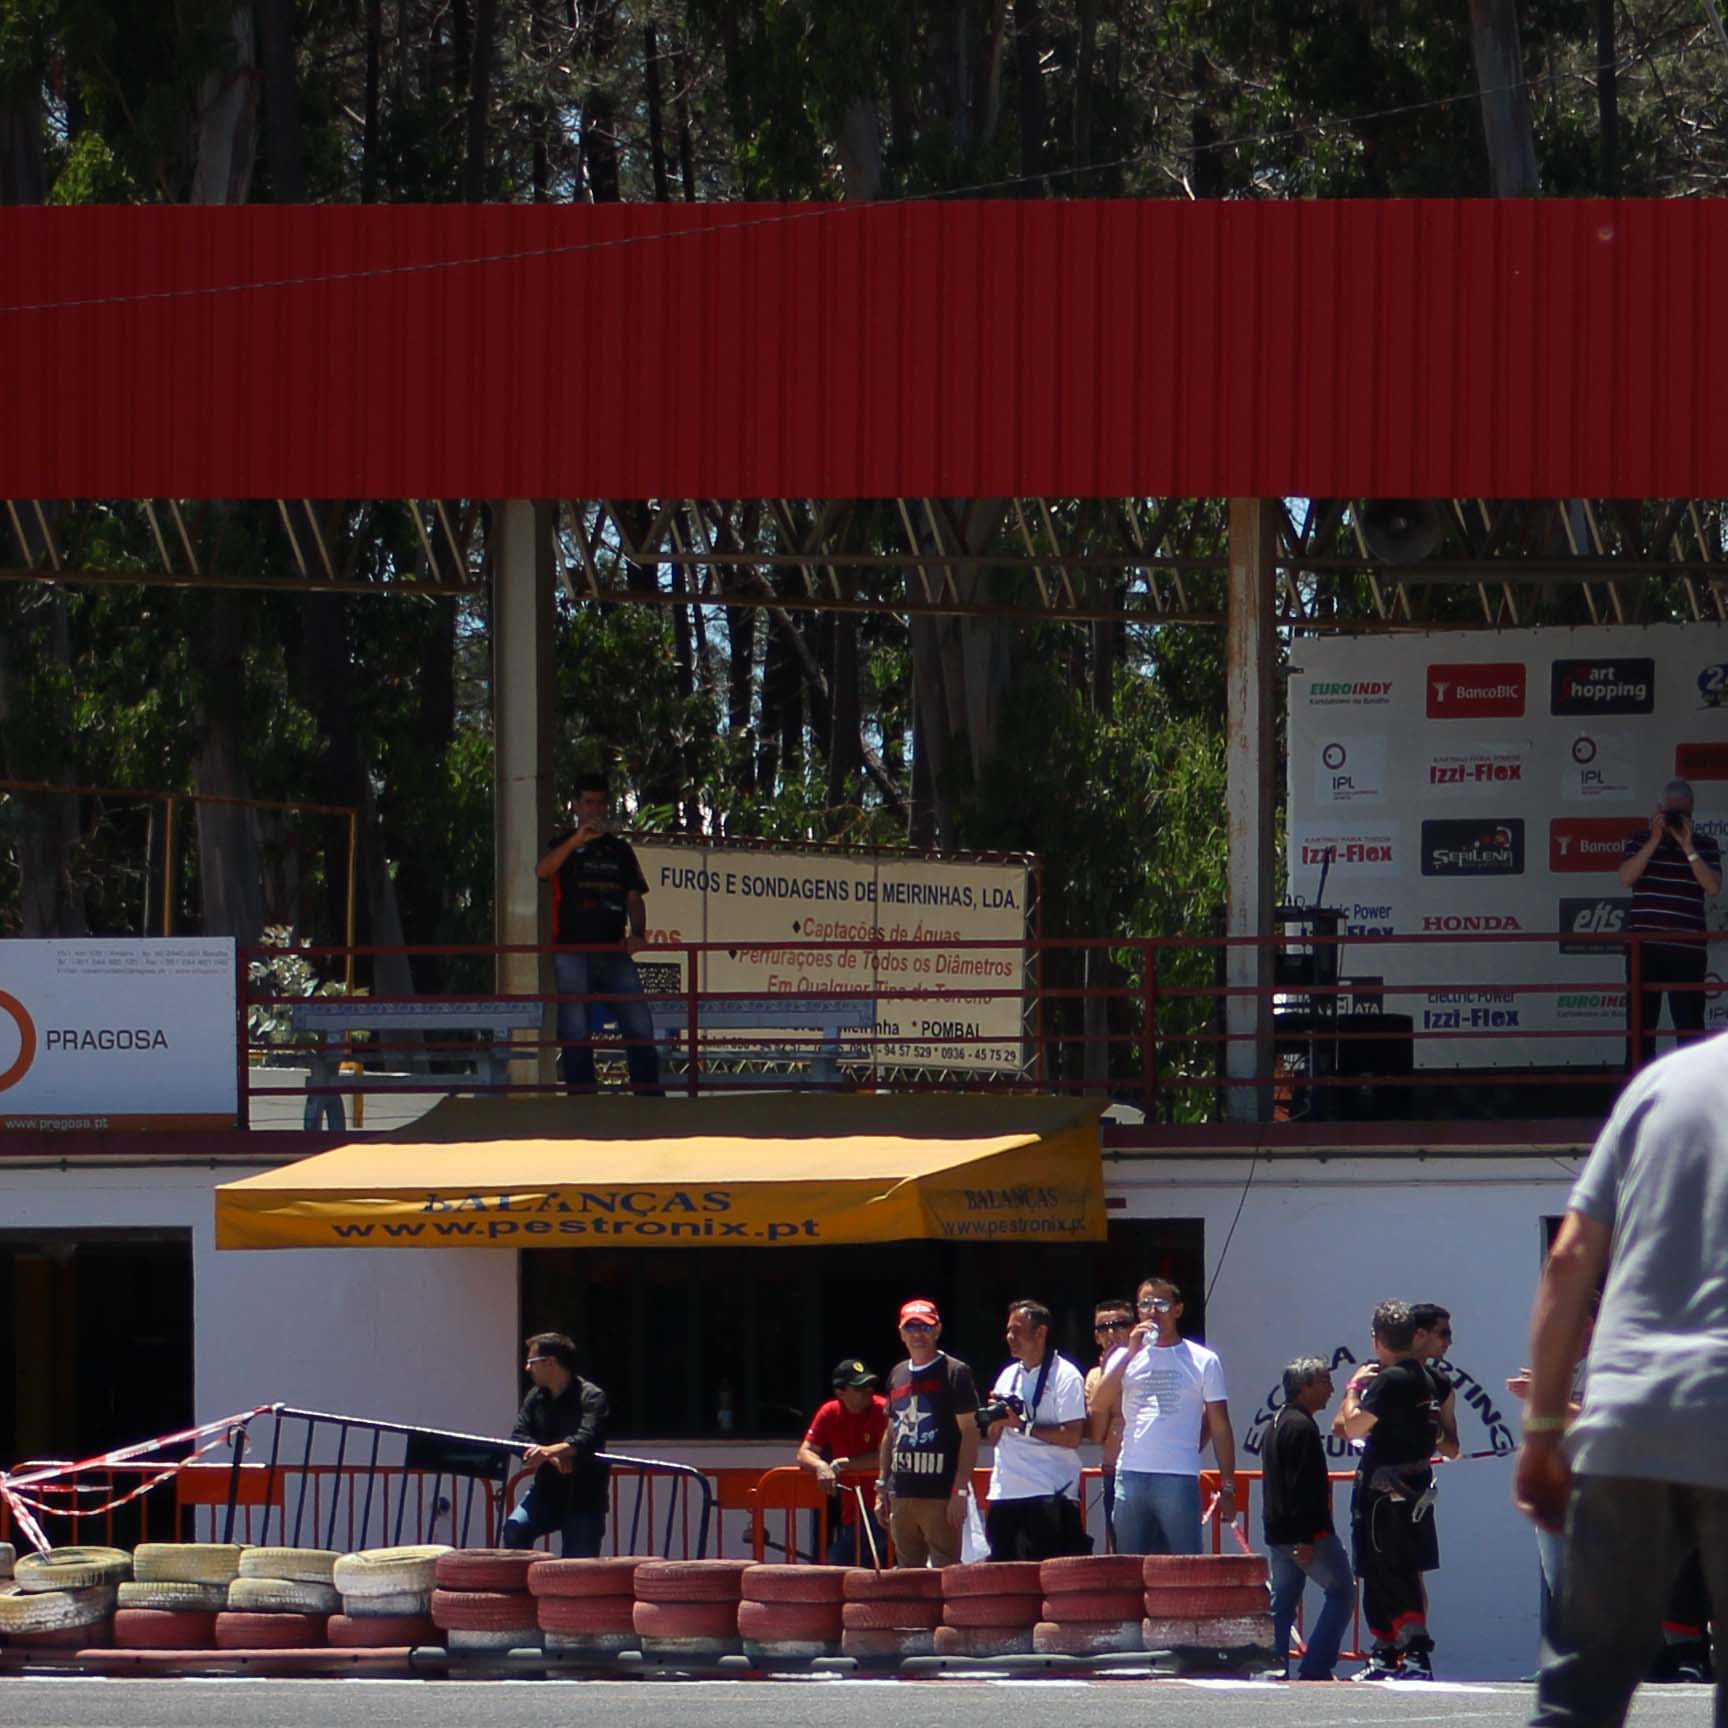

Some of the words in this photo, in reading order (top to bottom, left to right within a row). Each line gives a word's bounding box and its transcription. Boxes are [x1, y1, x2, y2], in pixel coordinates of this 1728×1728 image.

[1310, 681, 1393, 695] EUROINDY
[1456, 684, 1520, 700] BancoBIC
[1332, 776, 1355, 790] IPL
[1581, 770, 1605, 785] IPL
[661, 867, 720, 892] FUROS
[726, 874, 736, 894] E
[742, 875, 849, 900] SONDAGENS
[855, 881, 877, 902] DE
[882, 882, 977, 911] MEIRINHAS,
[982, 888, 1020, 910] LDA.
[1354, 903, 1393, 920] Power
[803, 916, 885, 942] Captações
[1423, 915, 1522, 931] HONDA
[837, 949, 857, 968] de
[864, 950, 908, 971] Todos
[913, 957, 931, 973] os
[935, 954, 1012, 977] Diâmetros
[1423, 1008, 1520, 1029] Izzi-Flex
[46, 1029, 169, 1050] PRAGOSA
[332, 1216, 821, 1240] www.pestronix.pt
